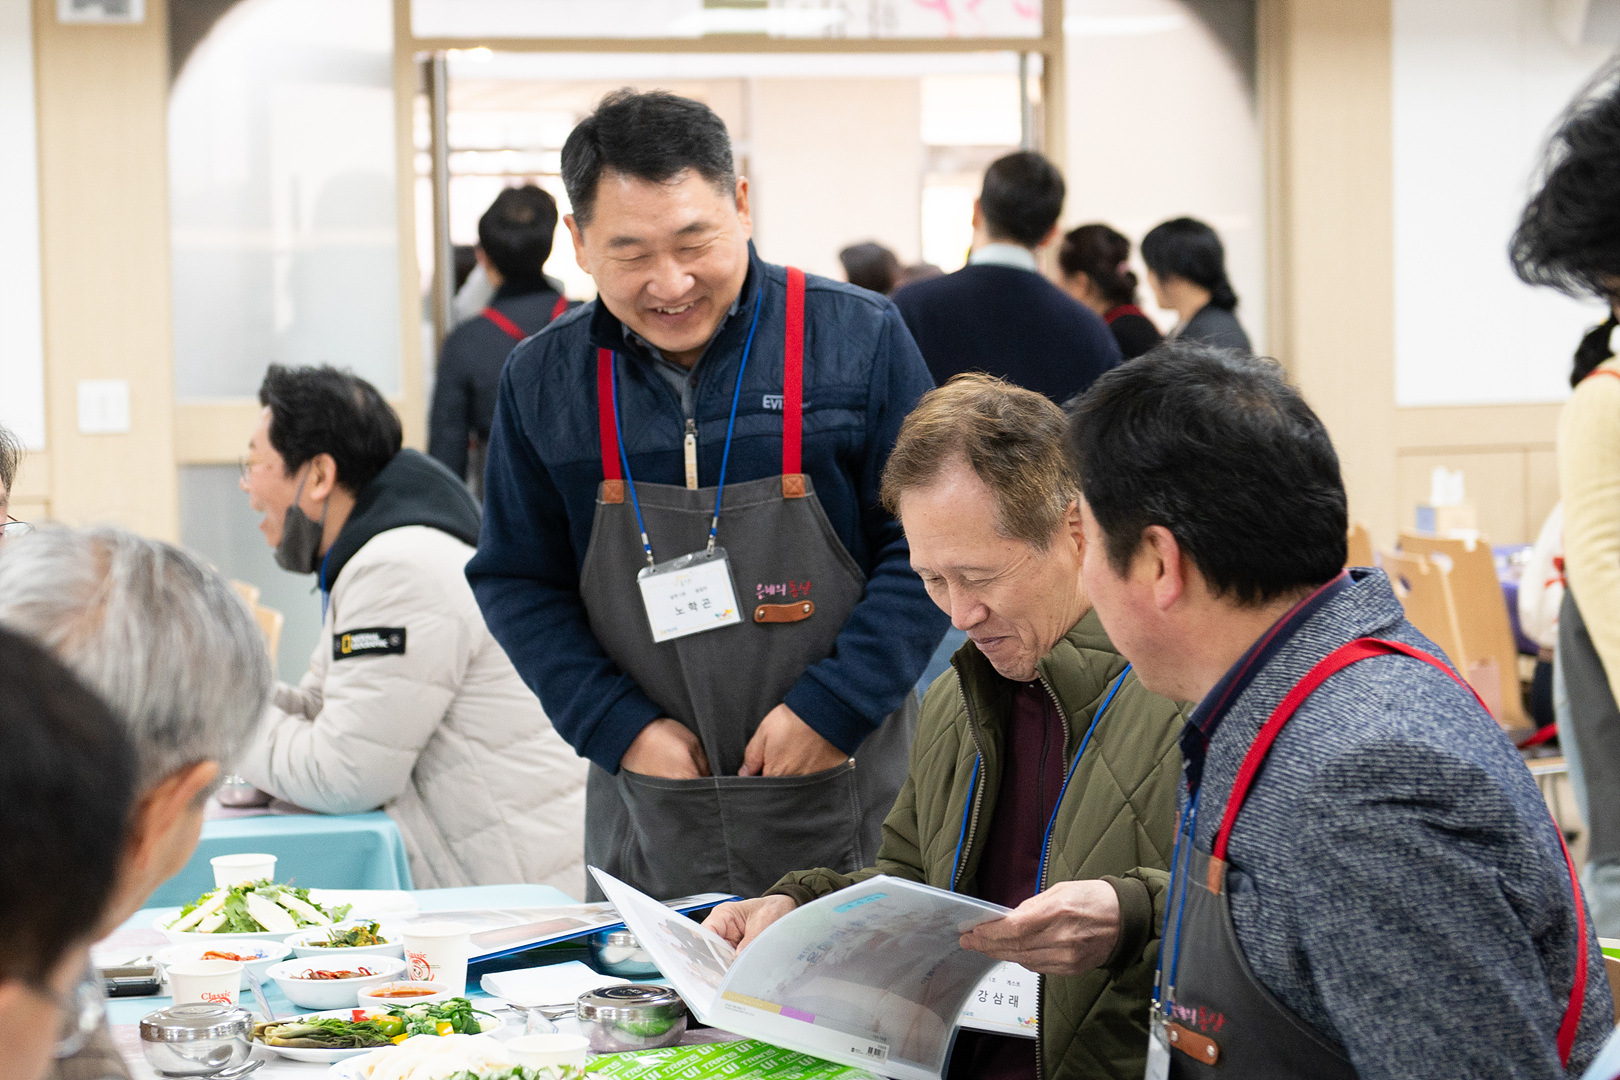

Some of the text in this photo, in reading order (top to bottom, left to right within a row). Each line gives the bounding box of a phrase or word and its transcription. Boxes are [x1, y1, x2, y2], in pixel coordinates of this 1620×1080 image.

[763, 394, 784, 410] EVI
[201, 990, 231, 1001] Classic
[697, 1045, 716, 1056] UI
[682, 1066, 701, 1079] UI
[735, 1043, 754, 1053] UI
[760, 1059, 779, 1070] UI
[721, 1062, 741, 1075] UI
